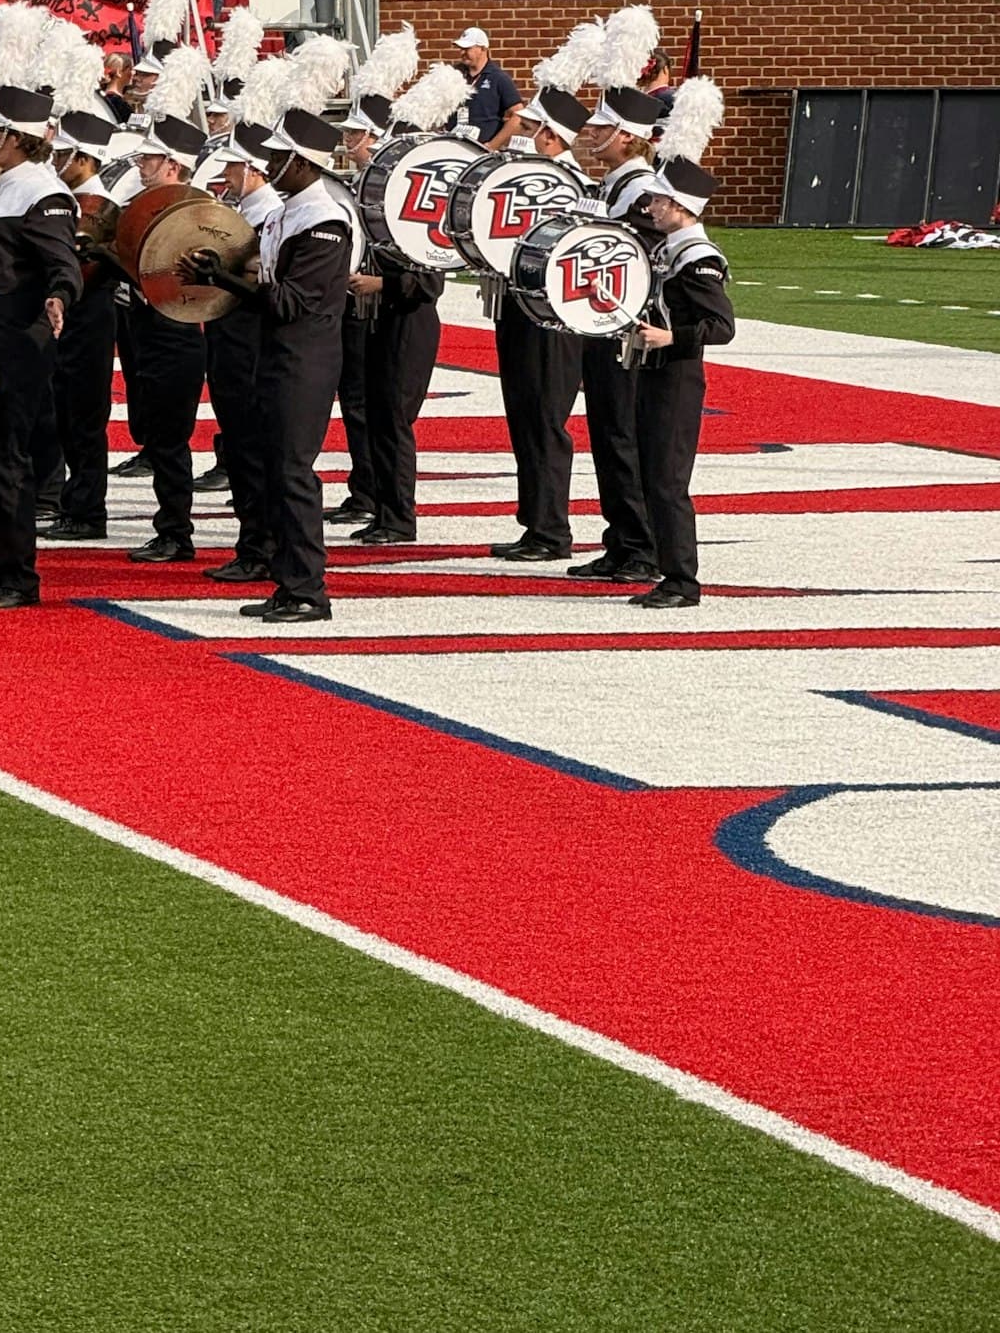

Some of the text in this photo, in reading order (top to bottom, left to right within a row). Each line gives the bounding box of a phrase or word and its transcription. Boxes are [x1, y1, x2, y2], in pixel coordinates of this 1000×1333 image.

[43, 208, 73, 217] LIBERTY
[311, 230, 342, 244] LIBERTY
[555, 254, 629, 314] LU
